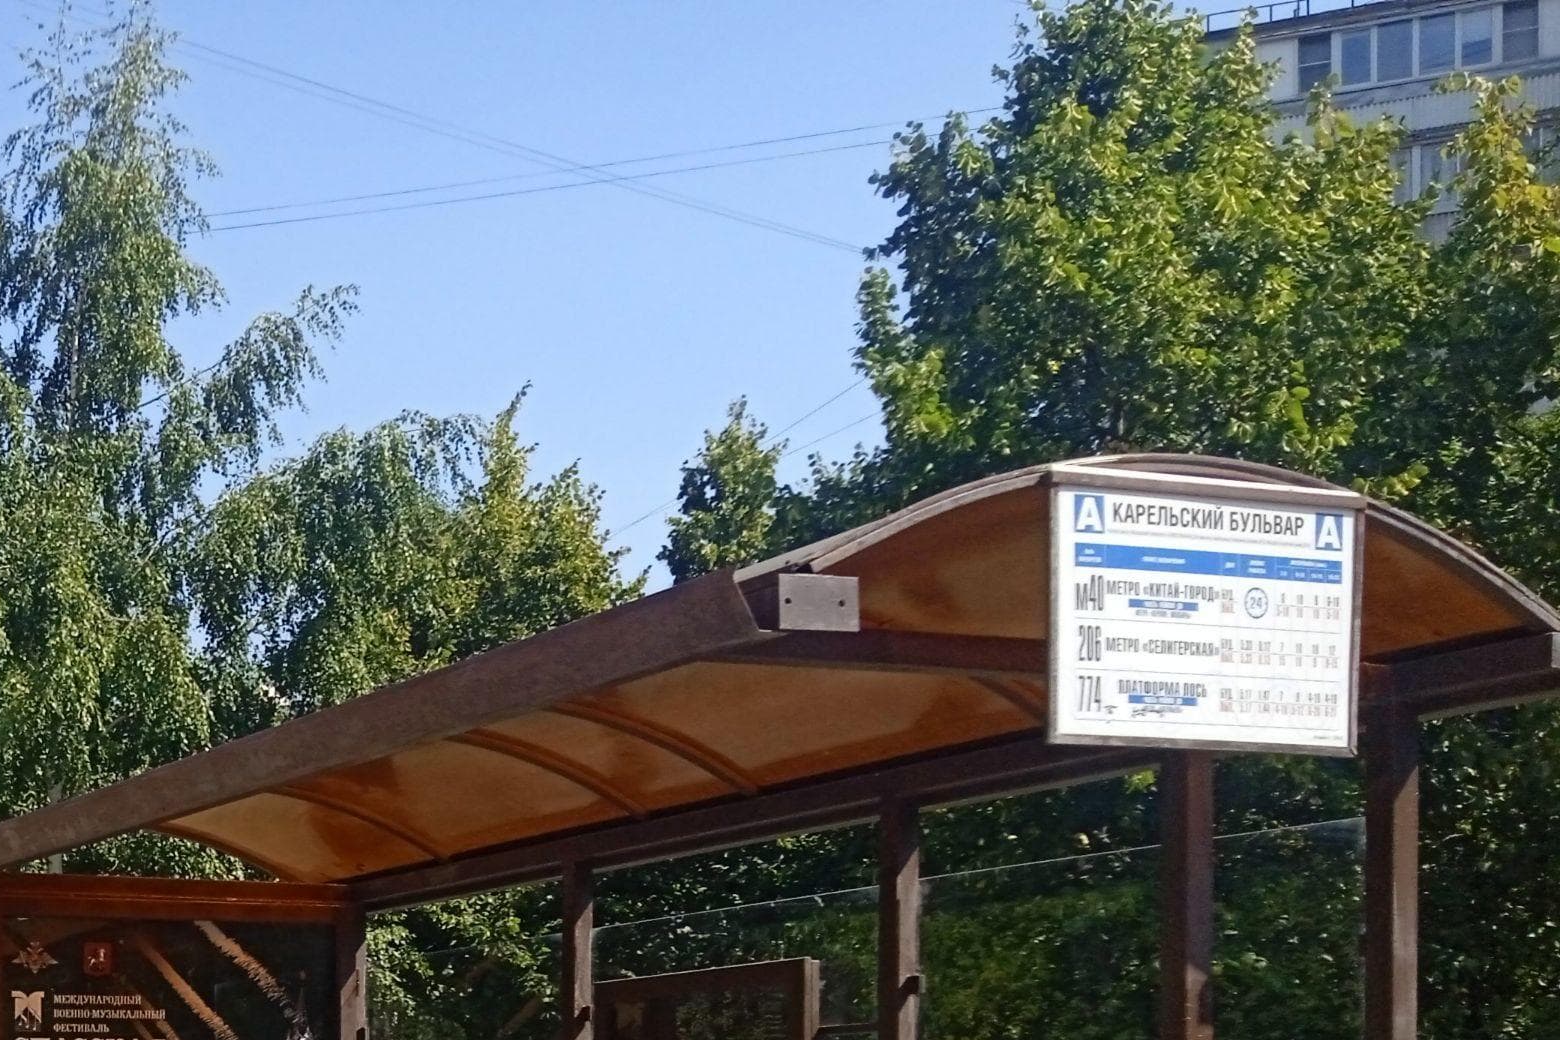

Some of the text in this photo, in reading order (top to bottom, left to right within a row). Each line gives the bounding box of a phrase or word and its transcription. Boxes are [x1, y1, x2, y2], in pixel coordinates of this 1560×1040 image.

[1112, 502, 1224, 530] КАРЕЛЬСКИЙ
[1229, 511, 1305, 536] БУЛЬВАР
[1106, 580, 1140, 596] МЕТРО
[1249, 596, 1263, 609] 24
[1078, 625, 1102, 661] 206
[1105, 637, 1220, 656] МЕТРО «СЕЛИГЕРСКАЯ»
[1118, 679, 1207, 698] ПЛАТФОРМА ЛОСЬ
[53, 994, 142, 1006] МЕЖДУНАРОДНЫЙ
[53, 1008, 166, 1020] ВОЕННО-МУЗЫКАЛЬНЫЙ
[53, 1023, 110, 1033] ФЕСТИВАЛЬ
